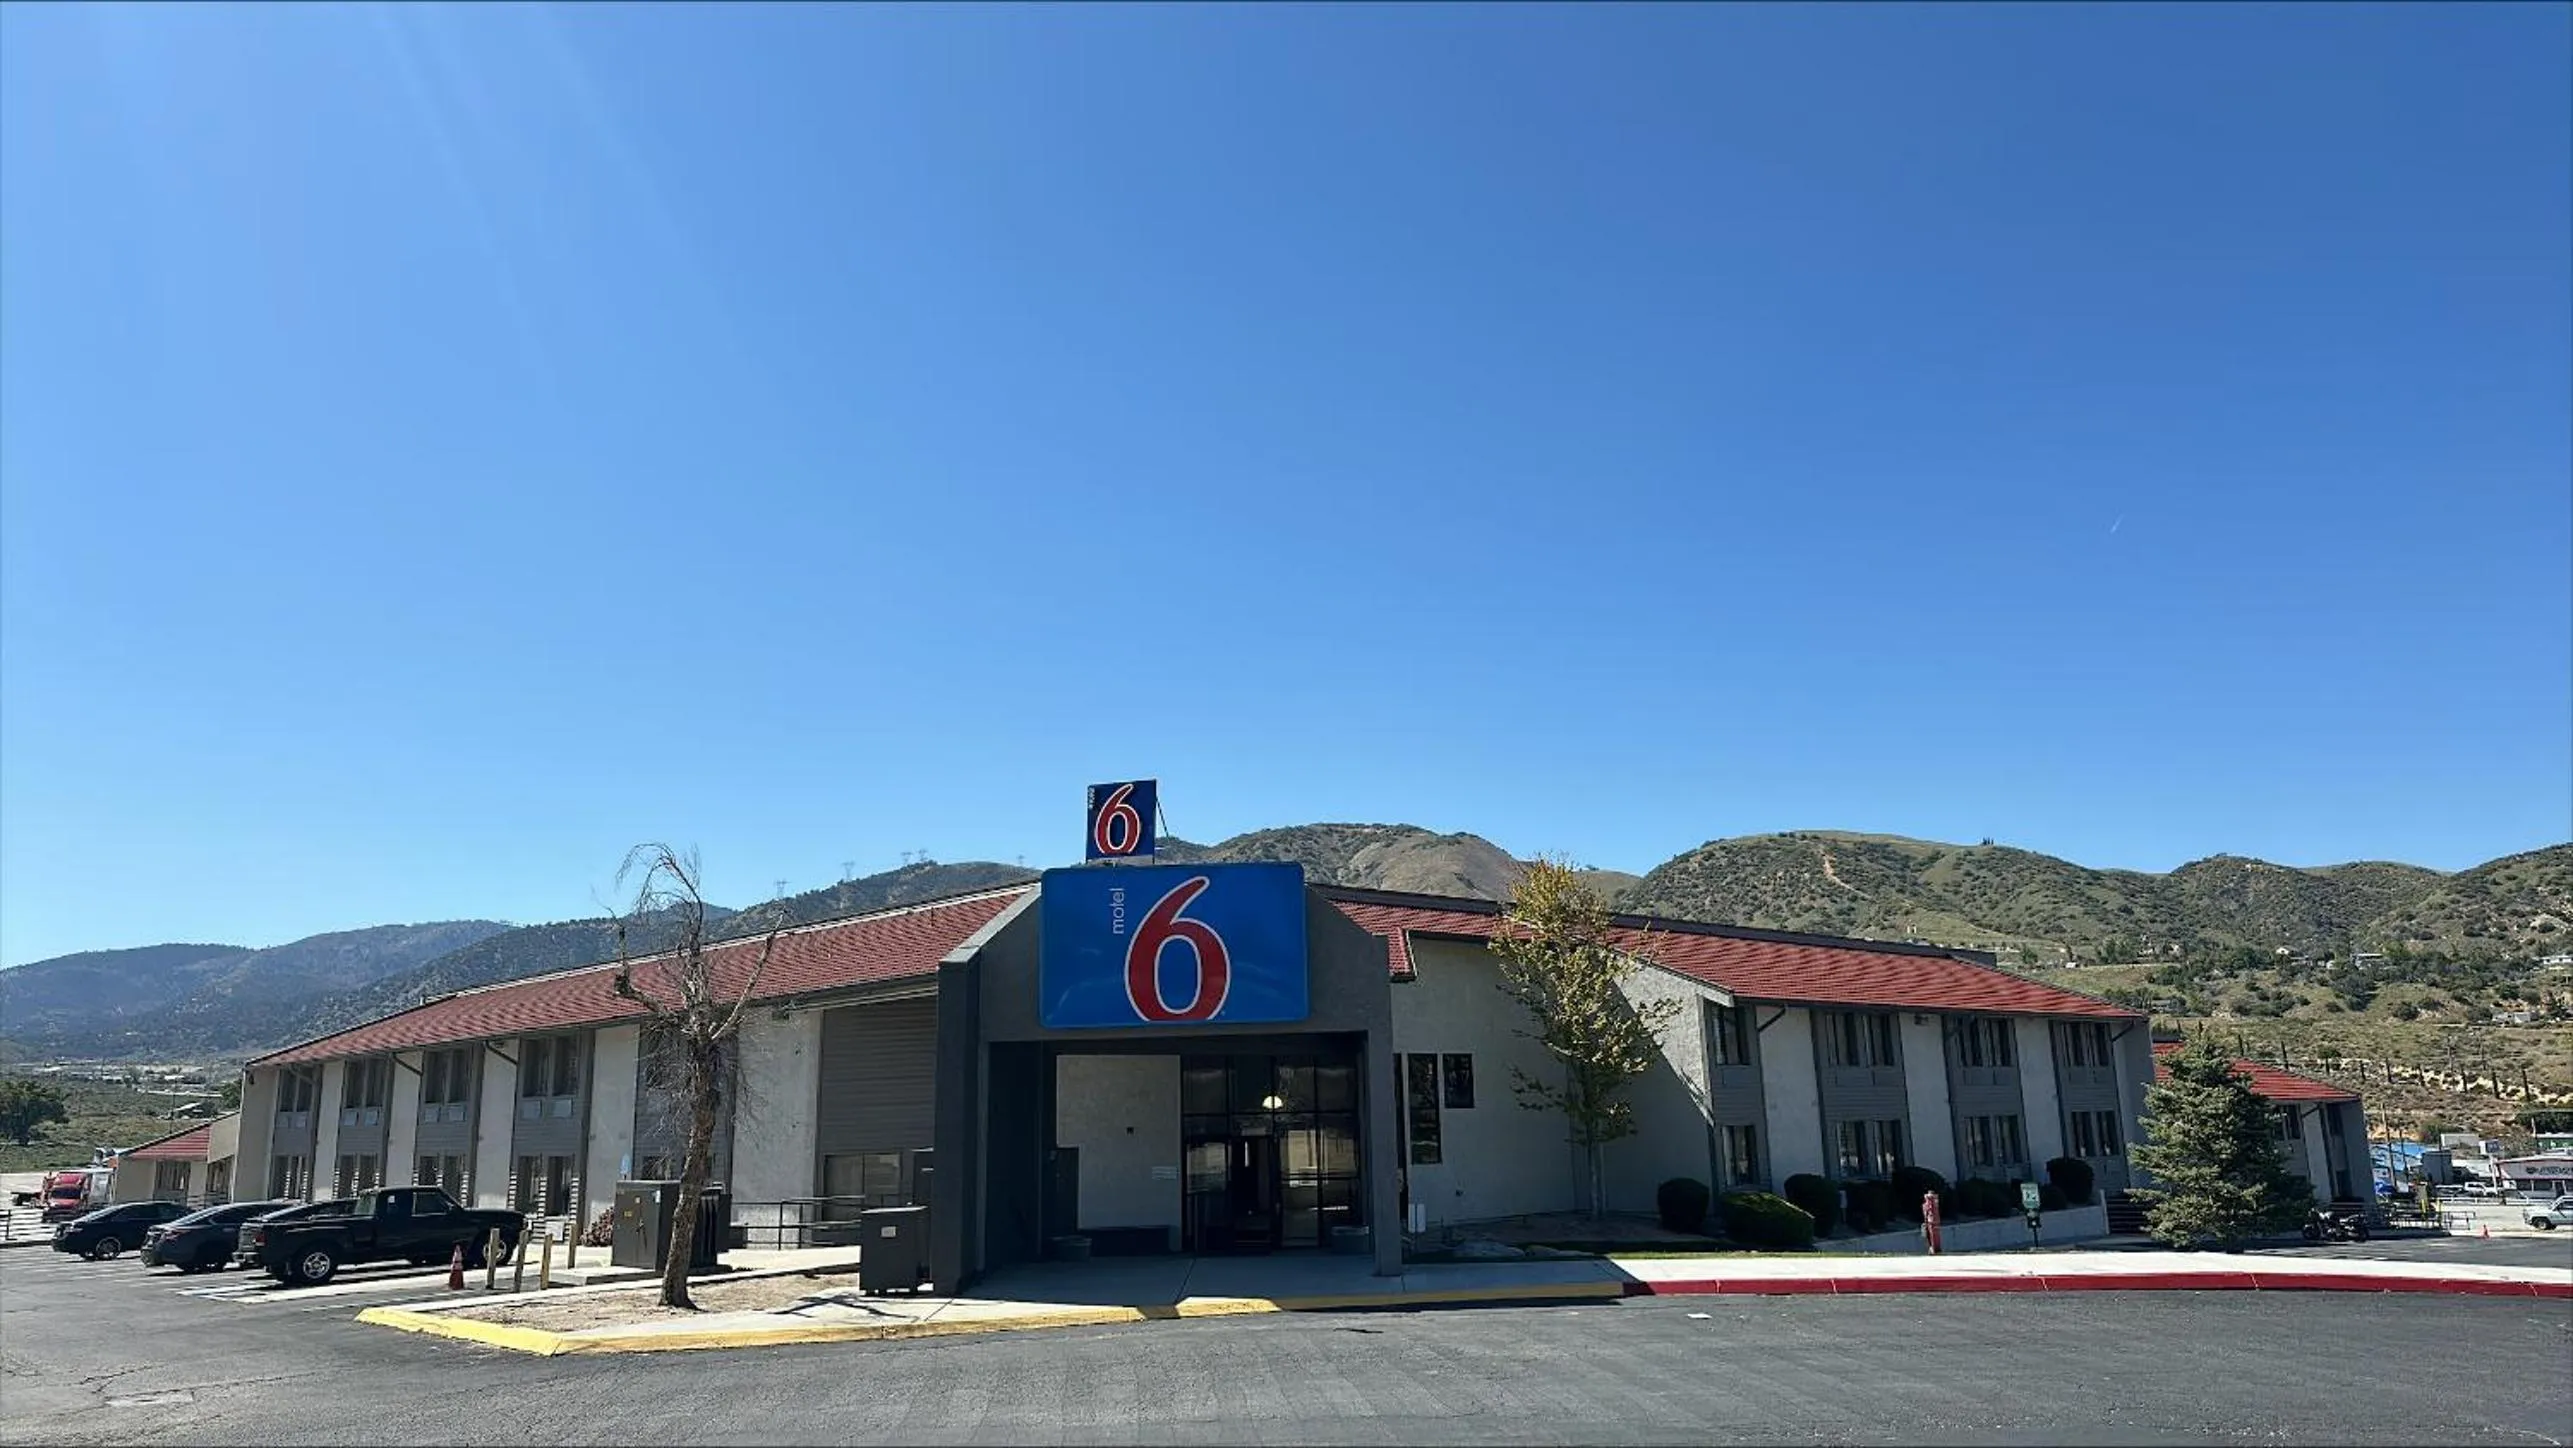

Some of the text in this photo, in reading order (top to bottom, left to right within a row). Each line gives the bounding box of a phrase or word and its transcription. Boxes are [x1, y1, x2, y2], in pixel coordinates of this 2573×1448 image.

[1095, 783, 1140, 855] 6
[1109, 888, 1125, 935] motel
[1124, 876, 1231, 1021] 6
